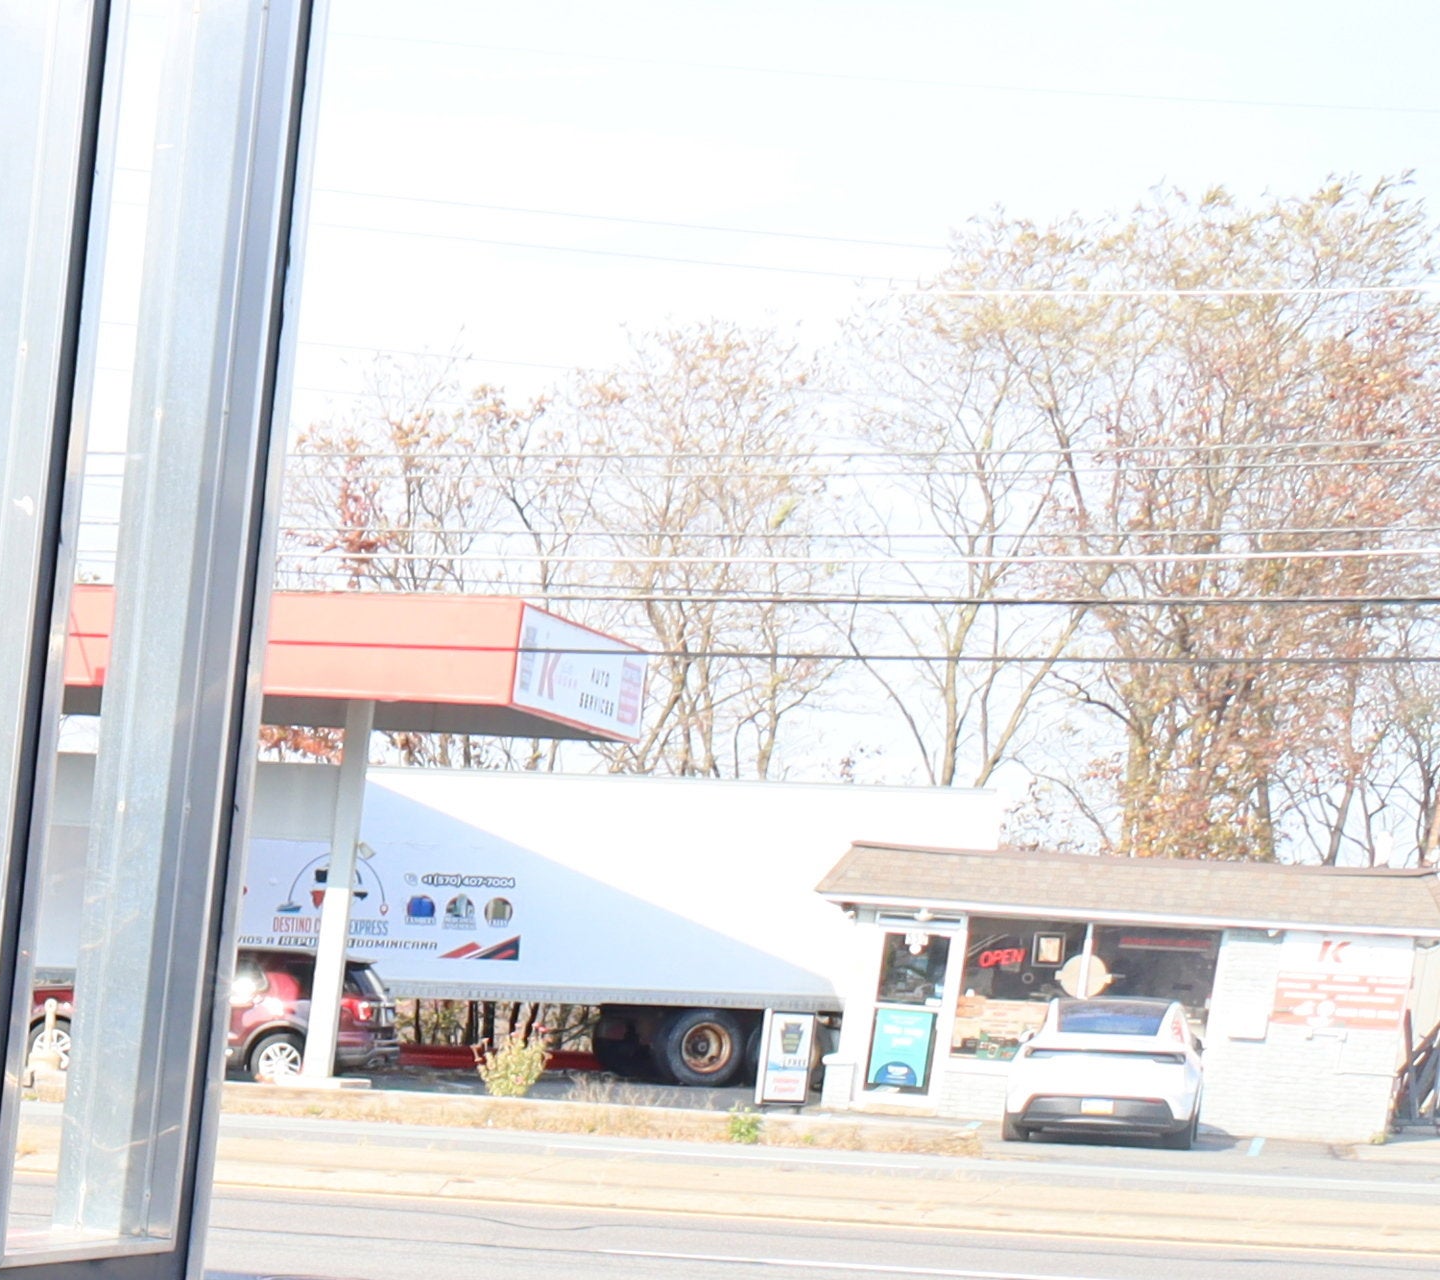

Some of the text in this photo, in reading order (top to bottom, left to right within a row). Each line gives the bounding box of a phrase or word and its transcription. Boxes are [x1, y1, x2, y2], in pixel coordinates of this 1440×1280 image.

[591, 668, 610, 688] AUTO
[579, 692, 614, 717] SERVICES
[462, 875, 515, 889] 407-7004
[272, 916, 311, 933] DESTINO
[348, 918, 389, 936] EXPRESS
[357, 939, 438, 950] DOMINICANA
[979, 948, 1026, 968] OPEN
